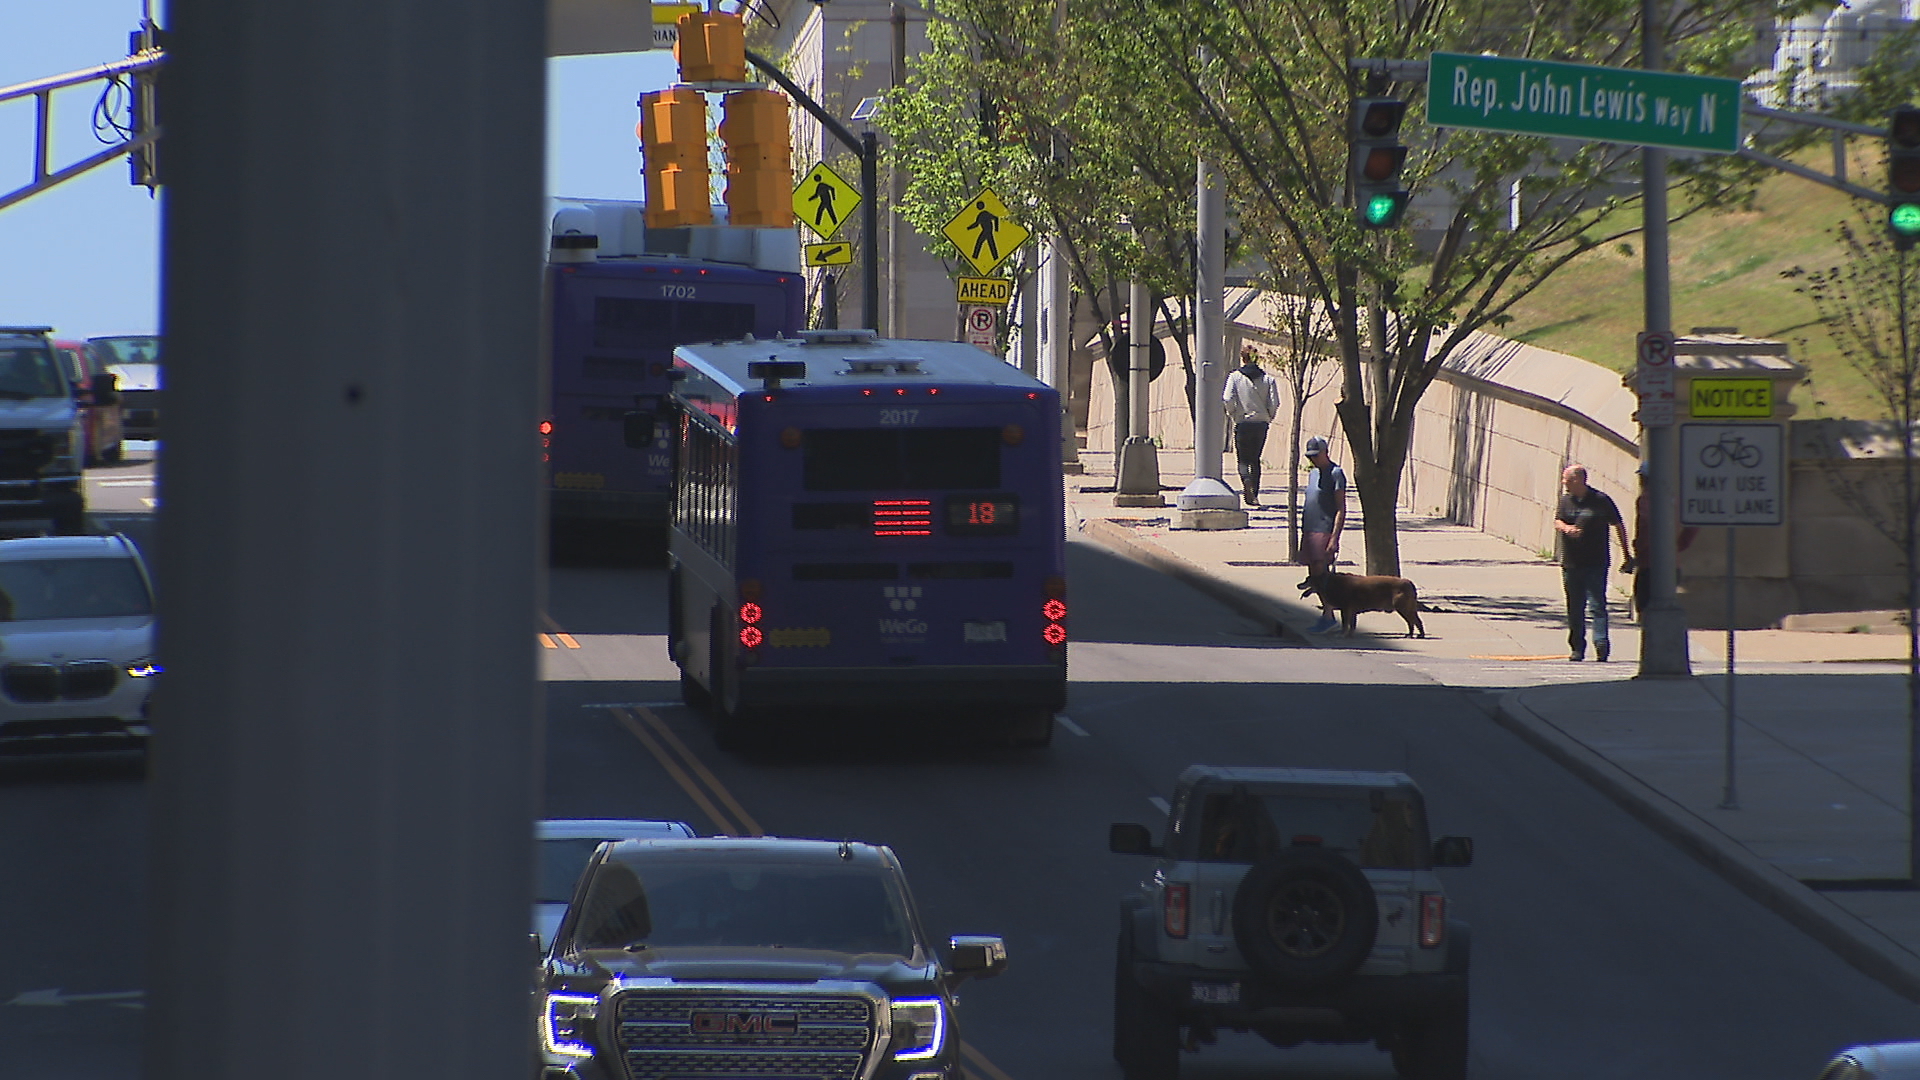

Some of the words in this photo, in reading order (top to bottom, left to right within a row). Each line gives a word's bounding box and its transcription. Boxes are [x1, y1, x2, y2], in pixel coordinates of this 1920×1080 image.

[1453, 65, 1504, 118] Rep.
[1511, 71, 1572, 116] John
[1579, 76, 1647, 123] Lewis
[1655, 96, 1693, 136] Way
[1700, 93, 1717, 135] N
[660, 285, 696, 299] 1702
[960, 282, 1007, 299] AHEAD
[1695, 388, 1768, 408] NOTICE
[879, 409, 919, 425] 2017
[1695, 476, 1727, 492] MAY
[1735, 476, 1768, 492] USE
[1687, 498, 1726, 515] FULL
[1735, 498, 1775, 515] LANE
[878, 618, 929, 634] WeGo
[694, 1013, 795, 1033] GMC
